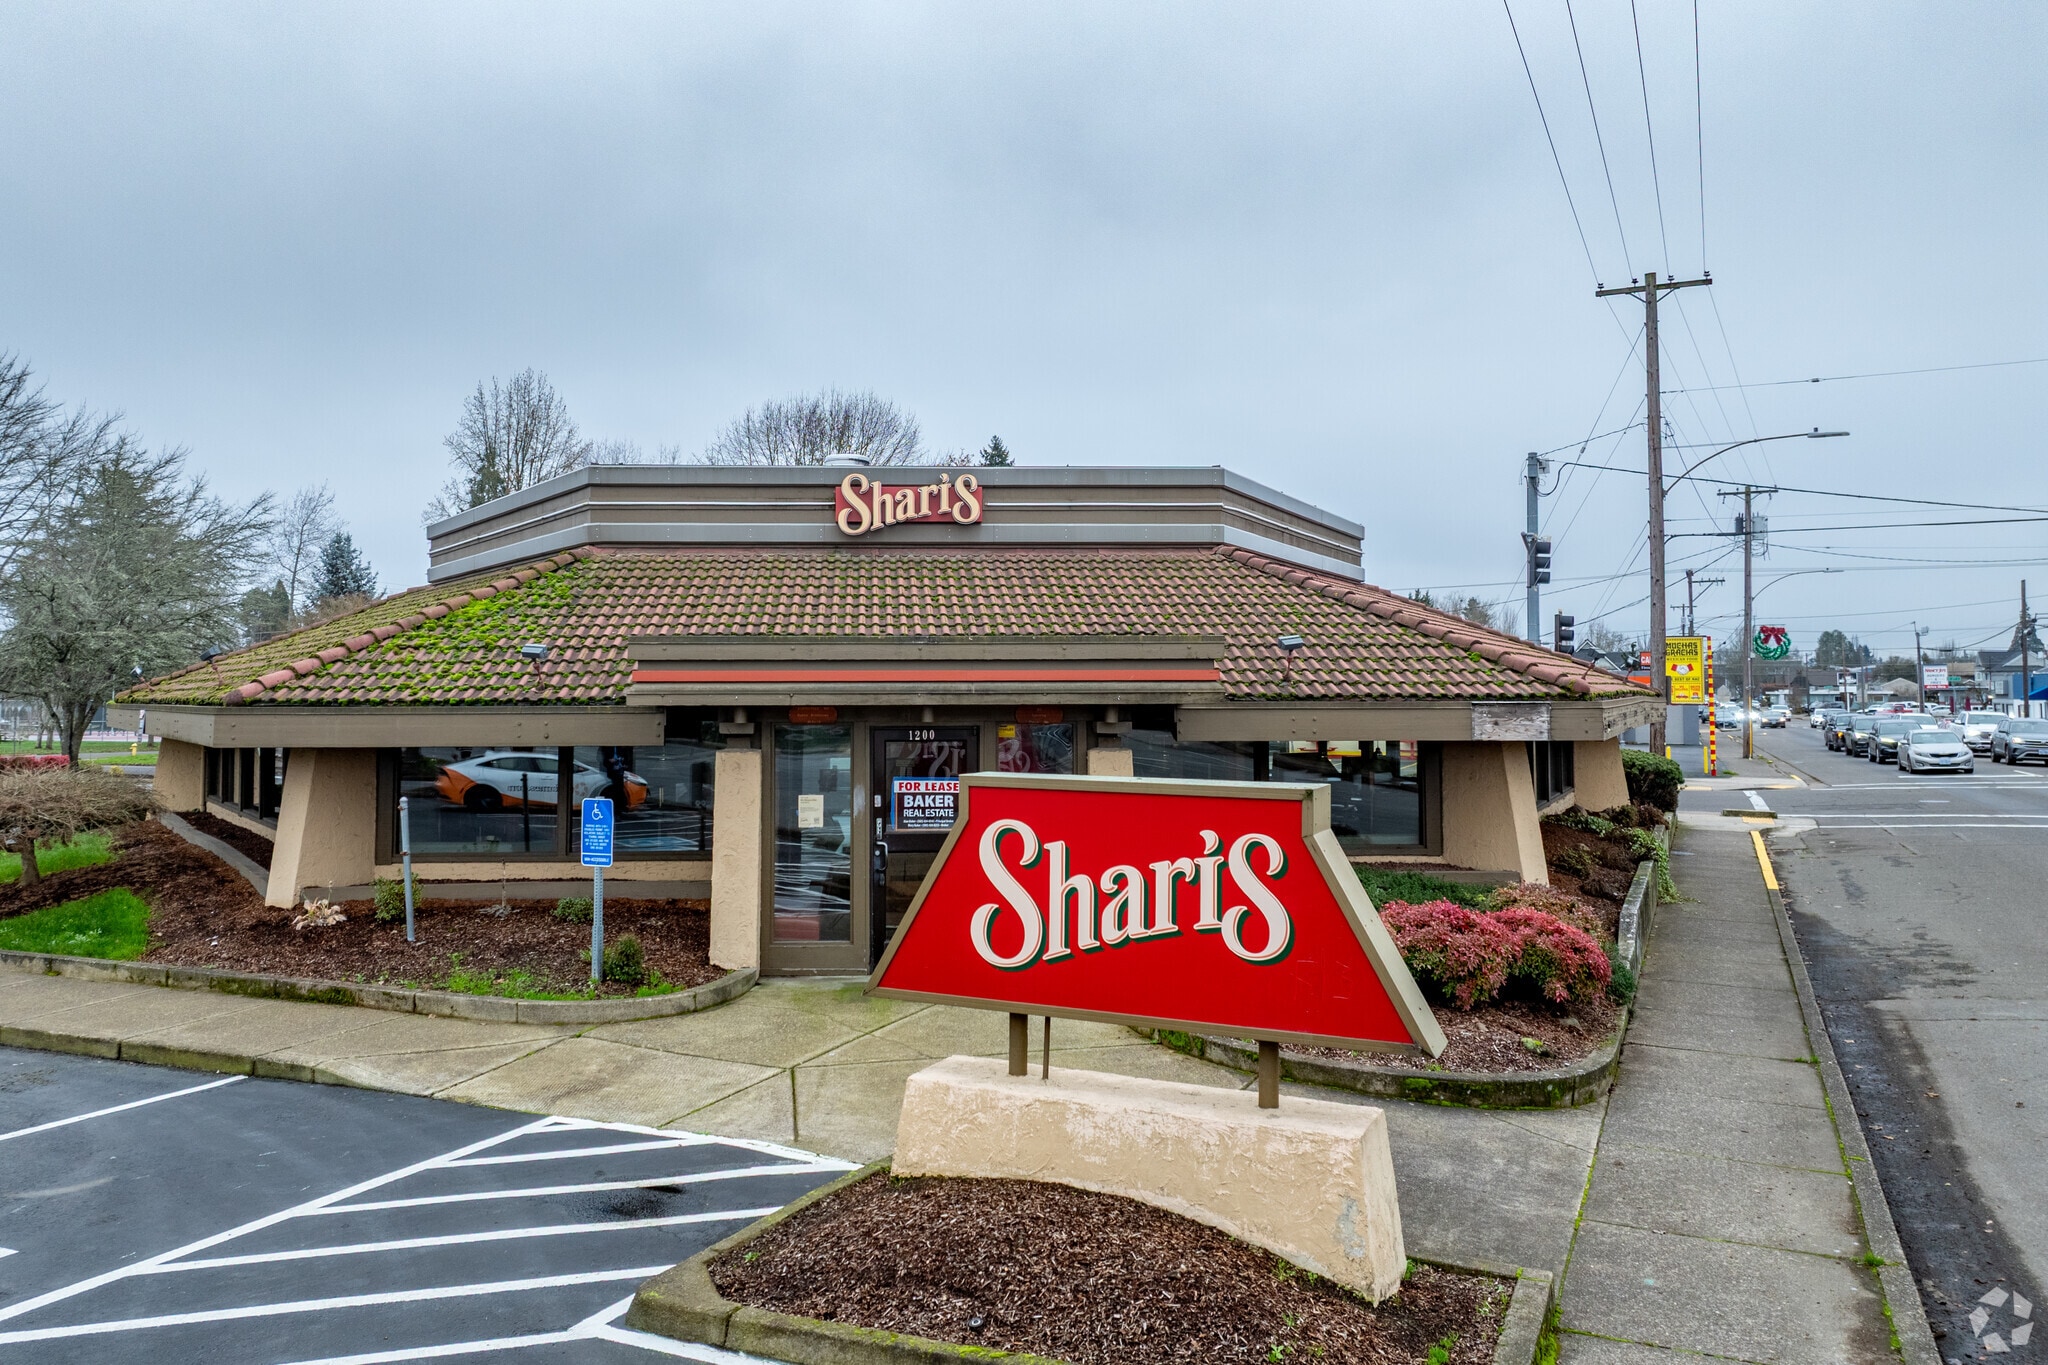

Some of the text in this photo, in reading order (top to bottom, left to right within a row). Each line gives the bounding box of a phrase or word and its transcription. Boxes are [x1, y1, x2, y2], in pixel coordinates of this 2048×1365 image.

[908, 730, 935, 740] 1200
[898, 782, 959, 792] FOR LEASE
[904, 794, 954, 808] BAKER
[903, 808, 954, 817] REAL ESTATE
